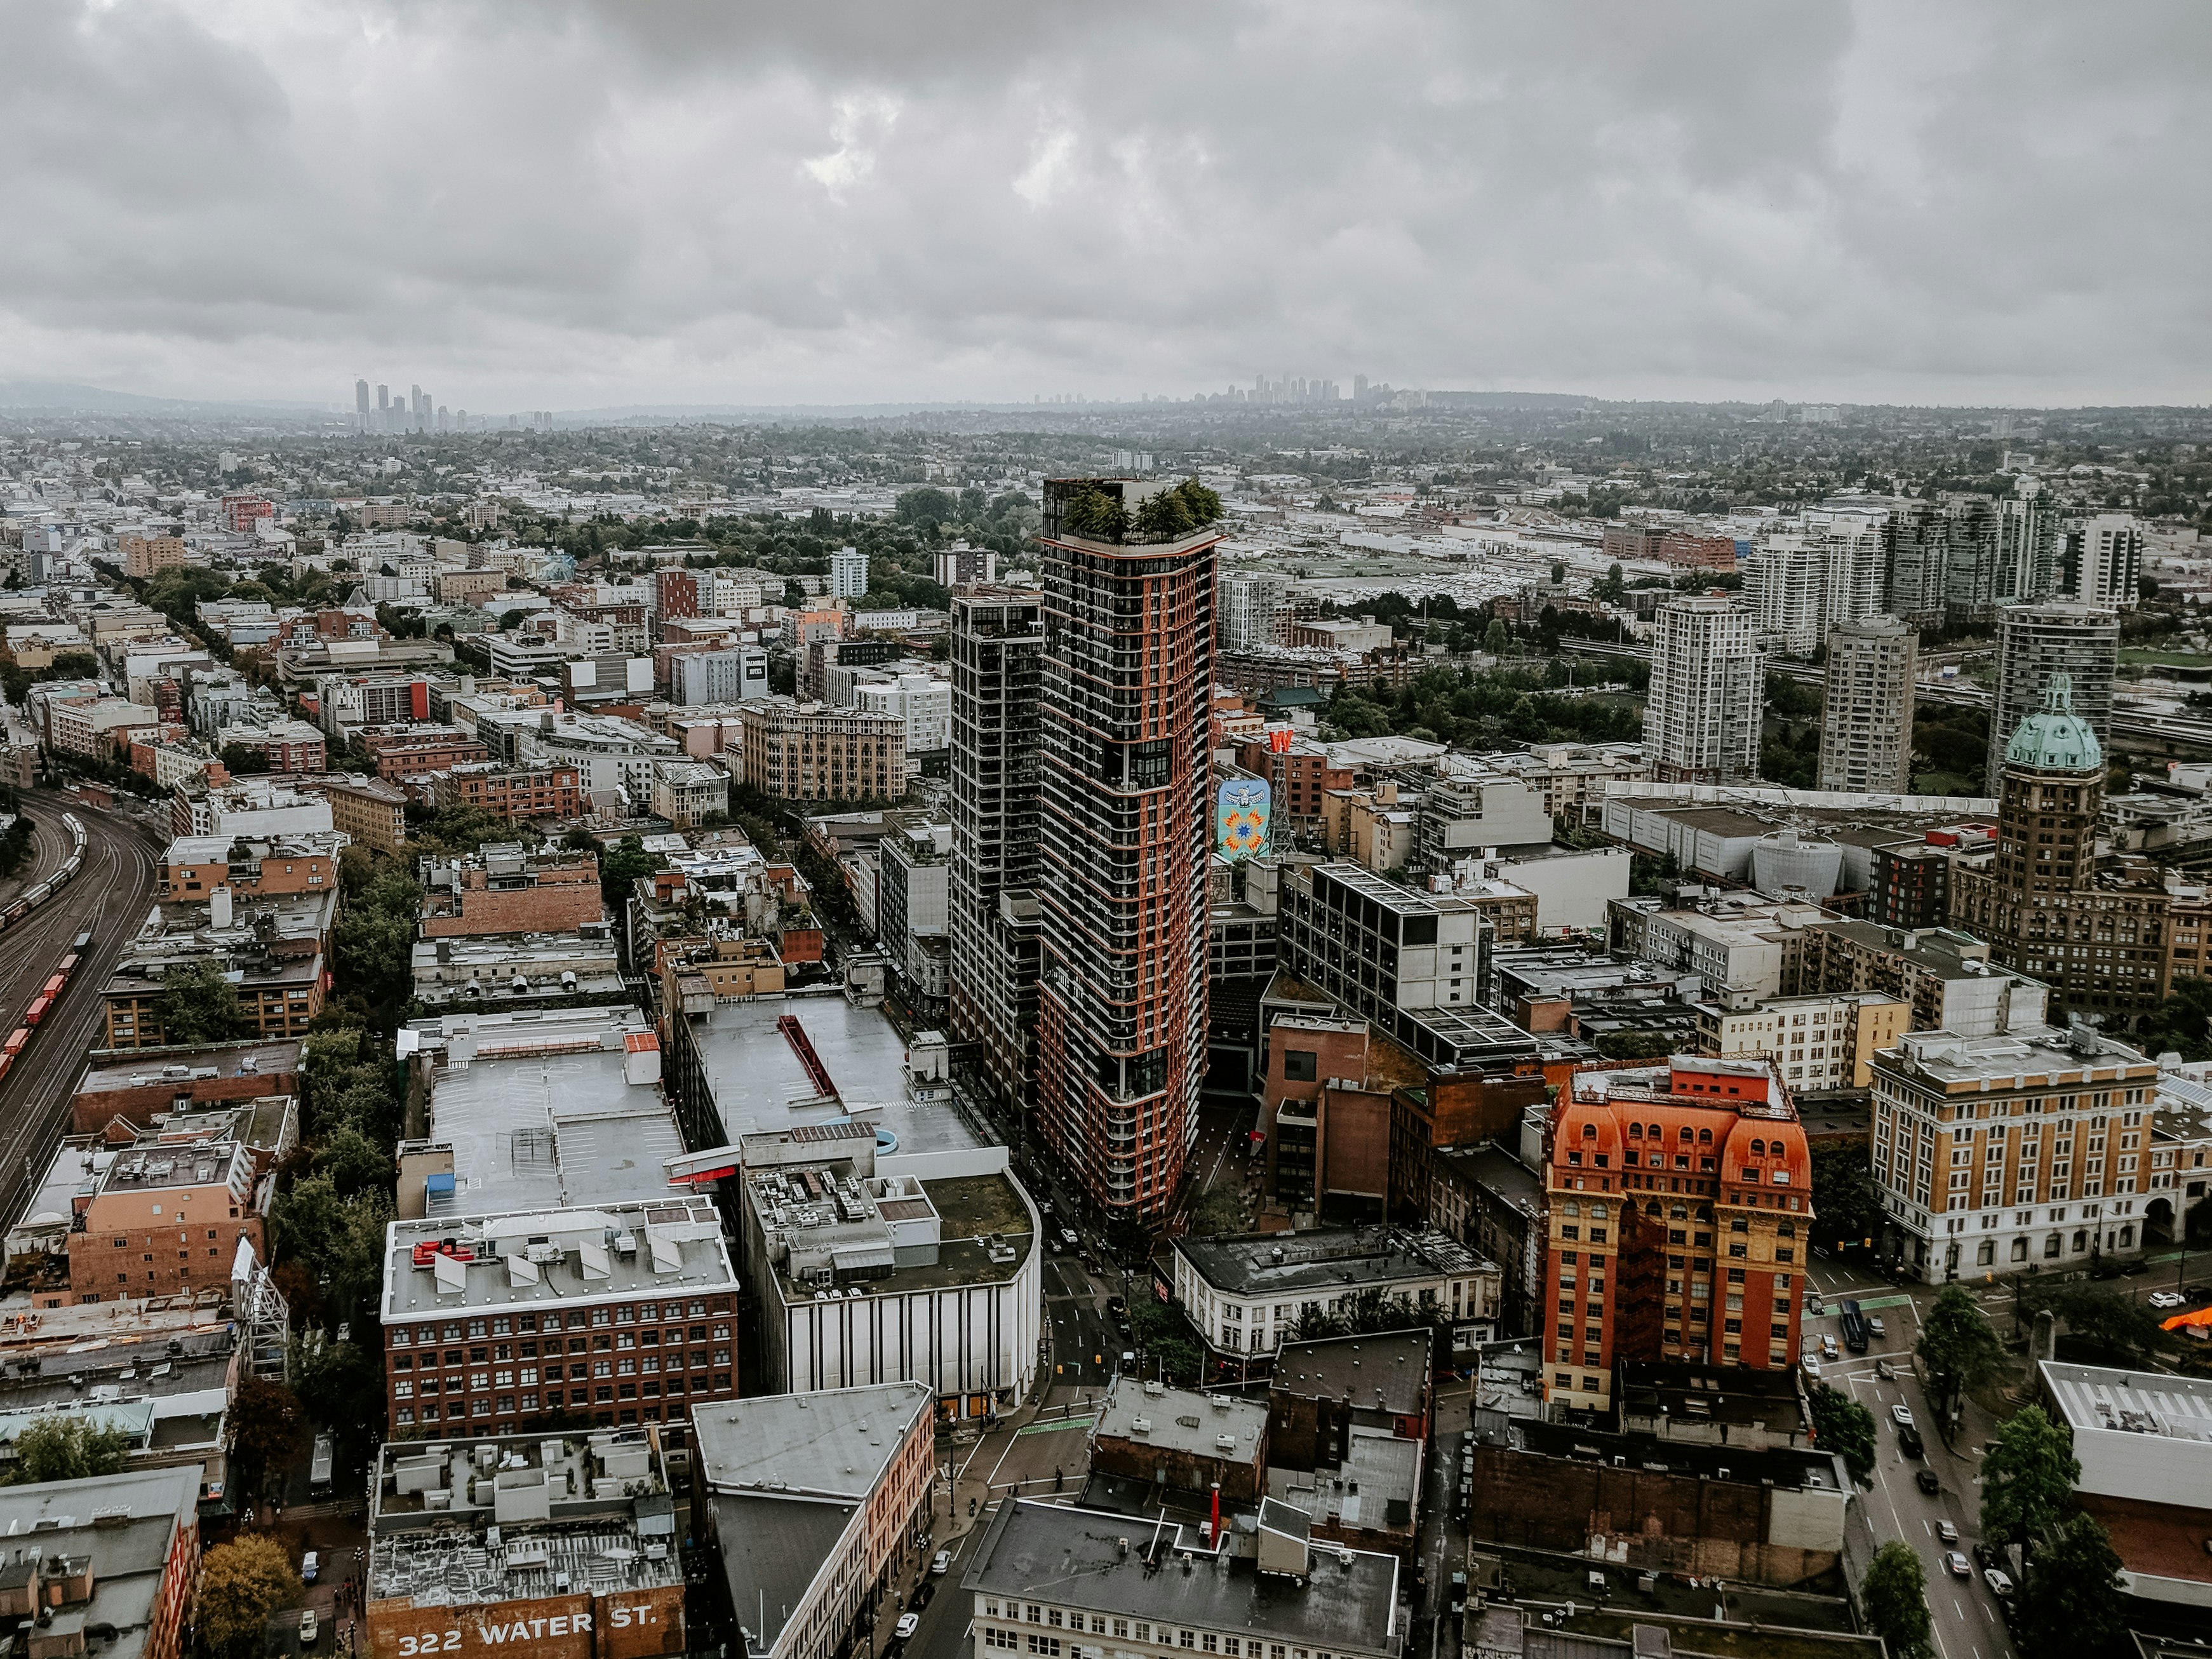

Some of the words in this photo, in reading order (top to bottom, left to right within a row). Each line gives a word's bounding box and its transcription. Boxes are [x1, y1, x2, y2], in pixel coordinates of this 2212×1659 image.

[1268, 730, 1294, 753] W
[1771, 888, 1816, 899] CINEPLEX
[398, 1630, 462, 1656] 322
[478, 1613, 593, 1645] WATER
[610, 1605, 657, 1628] ST.
